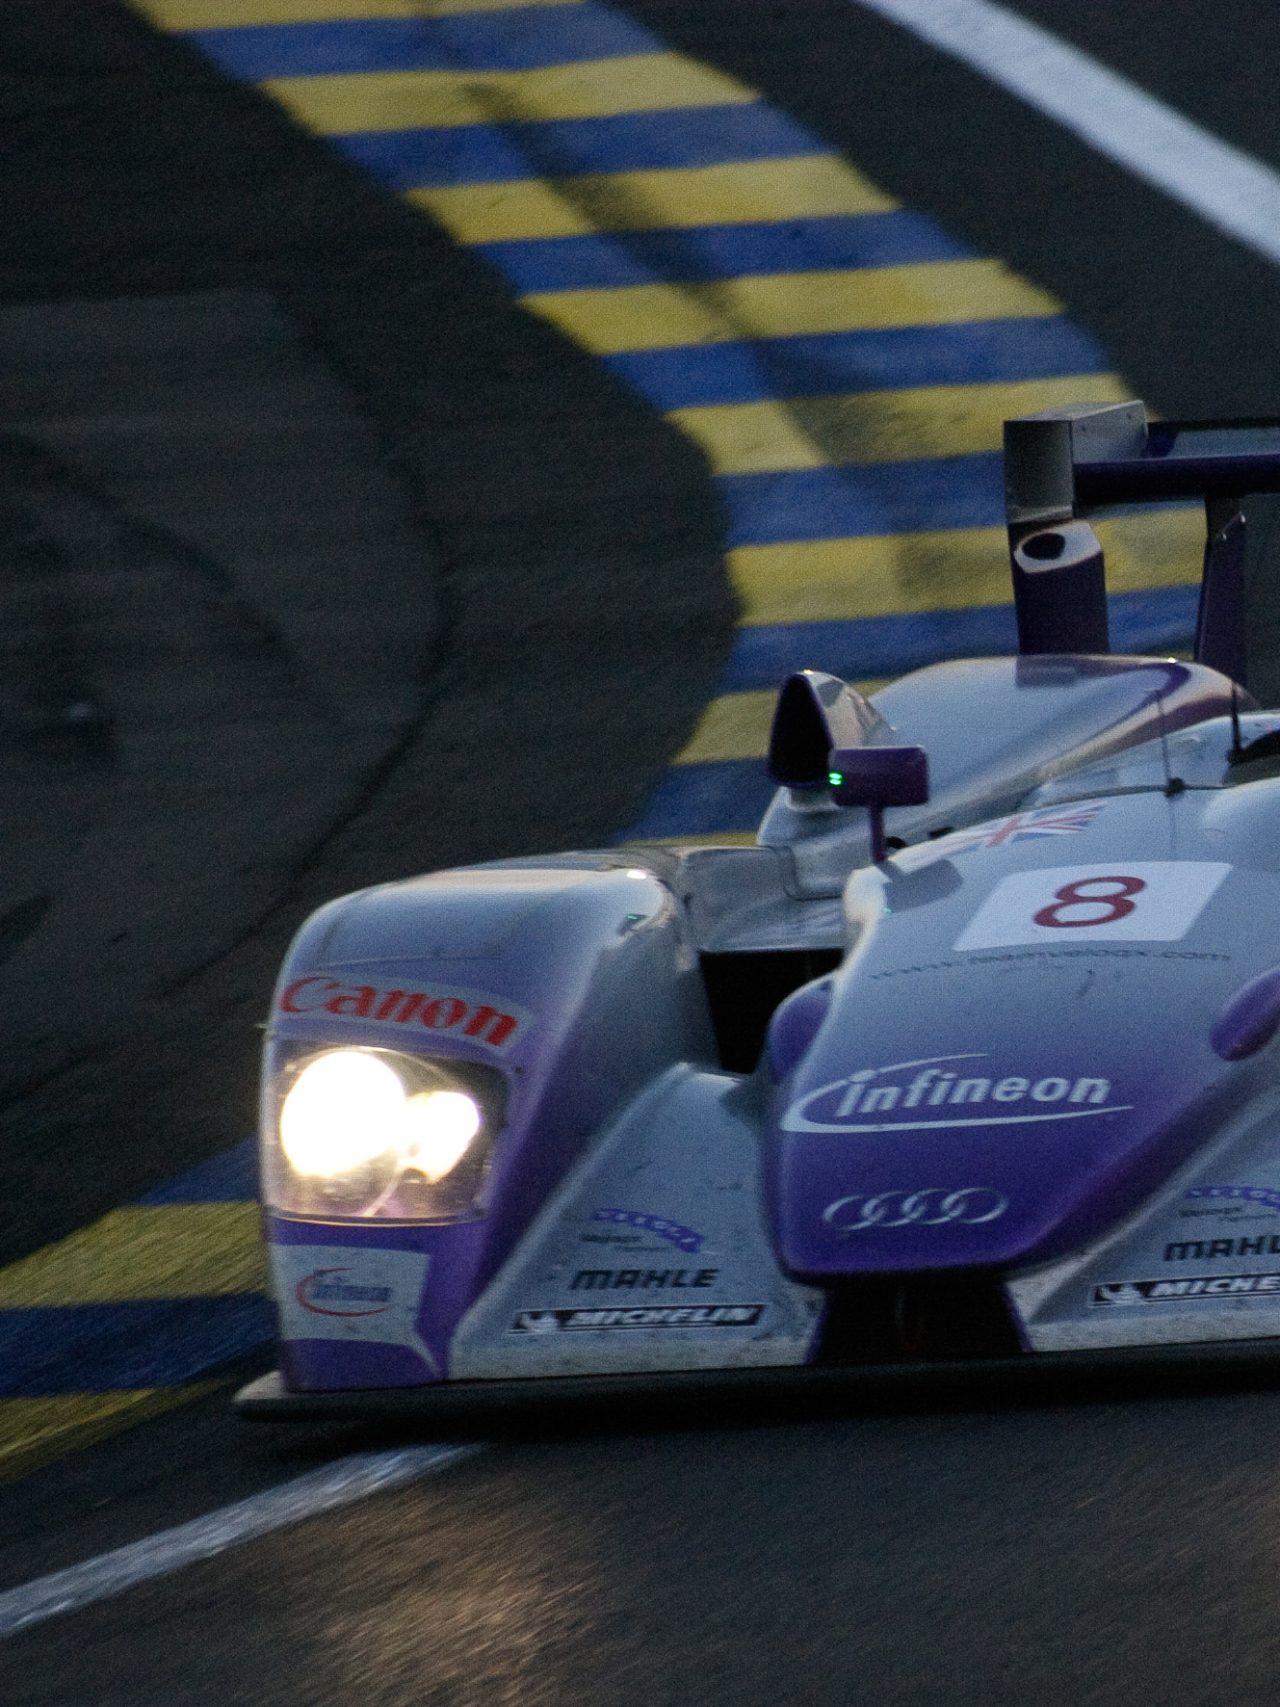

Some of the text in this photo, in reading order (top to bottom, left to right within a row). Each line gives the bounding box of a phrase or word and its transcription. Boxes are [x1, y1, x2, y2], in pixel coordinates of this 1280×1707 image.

[1032, 876, 1147, 928] 8
[281, 976, 517, 1047] Canon
[568, 1269, 721, 1290] MAHLE
